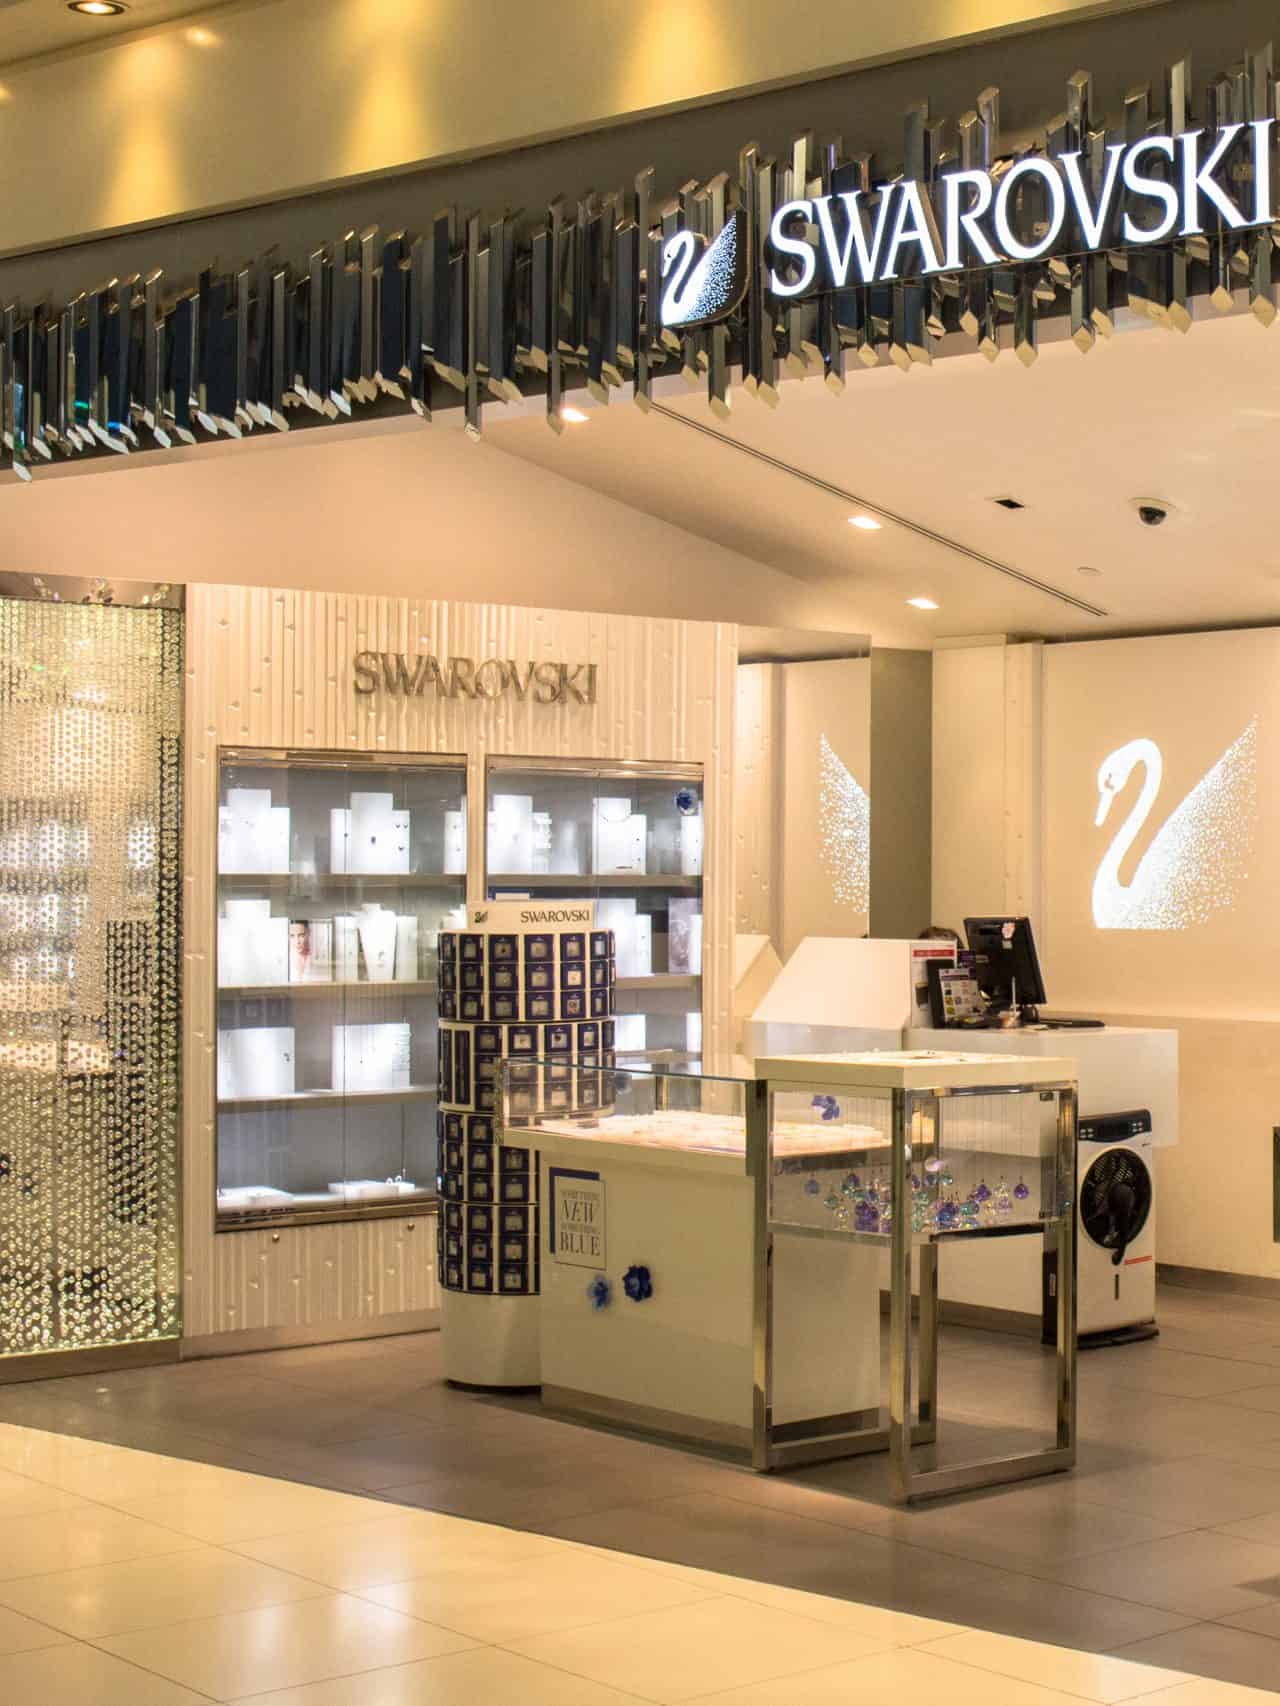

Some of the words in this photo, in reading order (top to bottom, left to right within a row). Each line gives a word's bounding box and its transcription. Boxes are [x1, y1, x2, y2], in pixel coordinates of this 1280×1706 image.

[769, 117, 1277, 298] SWAROVSKI
[353, 650, 598, 704] SWAROVSKI
[520, 909, 590, 924] SWAROVSKI
[561, 1199, 598, 1223] NEW
[560, 1231, 601, 1257] BLUE
